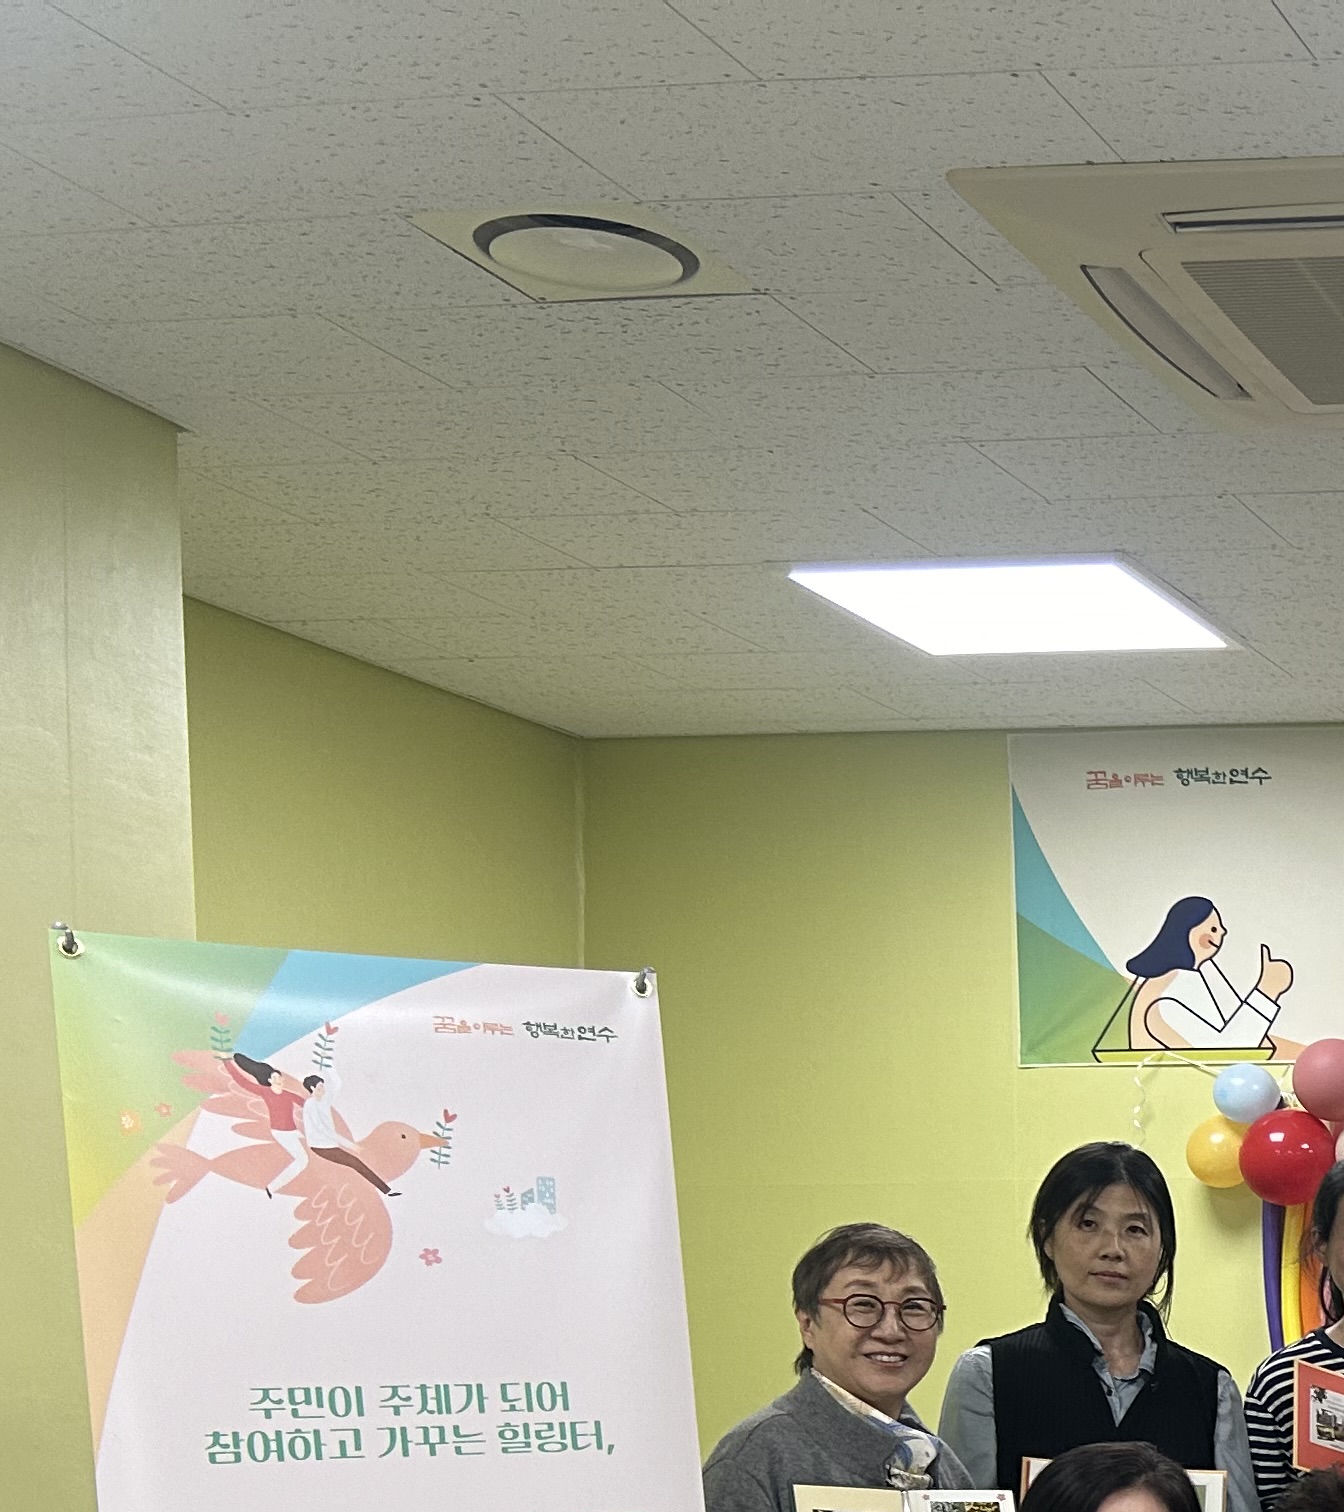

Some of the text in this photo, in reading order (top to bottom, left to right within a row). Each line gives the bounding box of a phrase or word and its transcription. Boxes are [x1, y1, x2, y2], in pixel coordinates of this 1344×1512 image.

[521, 1020, 619, 1044] 행복한연수
[248, 1381, 570, 1420] 주민이 주체가 되어
[204, 1419, 615, 1465] 참여하고 가꾸는 힐링터,
